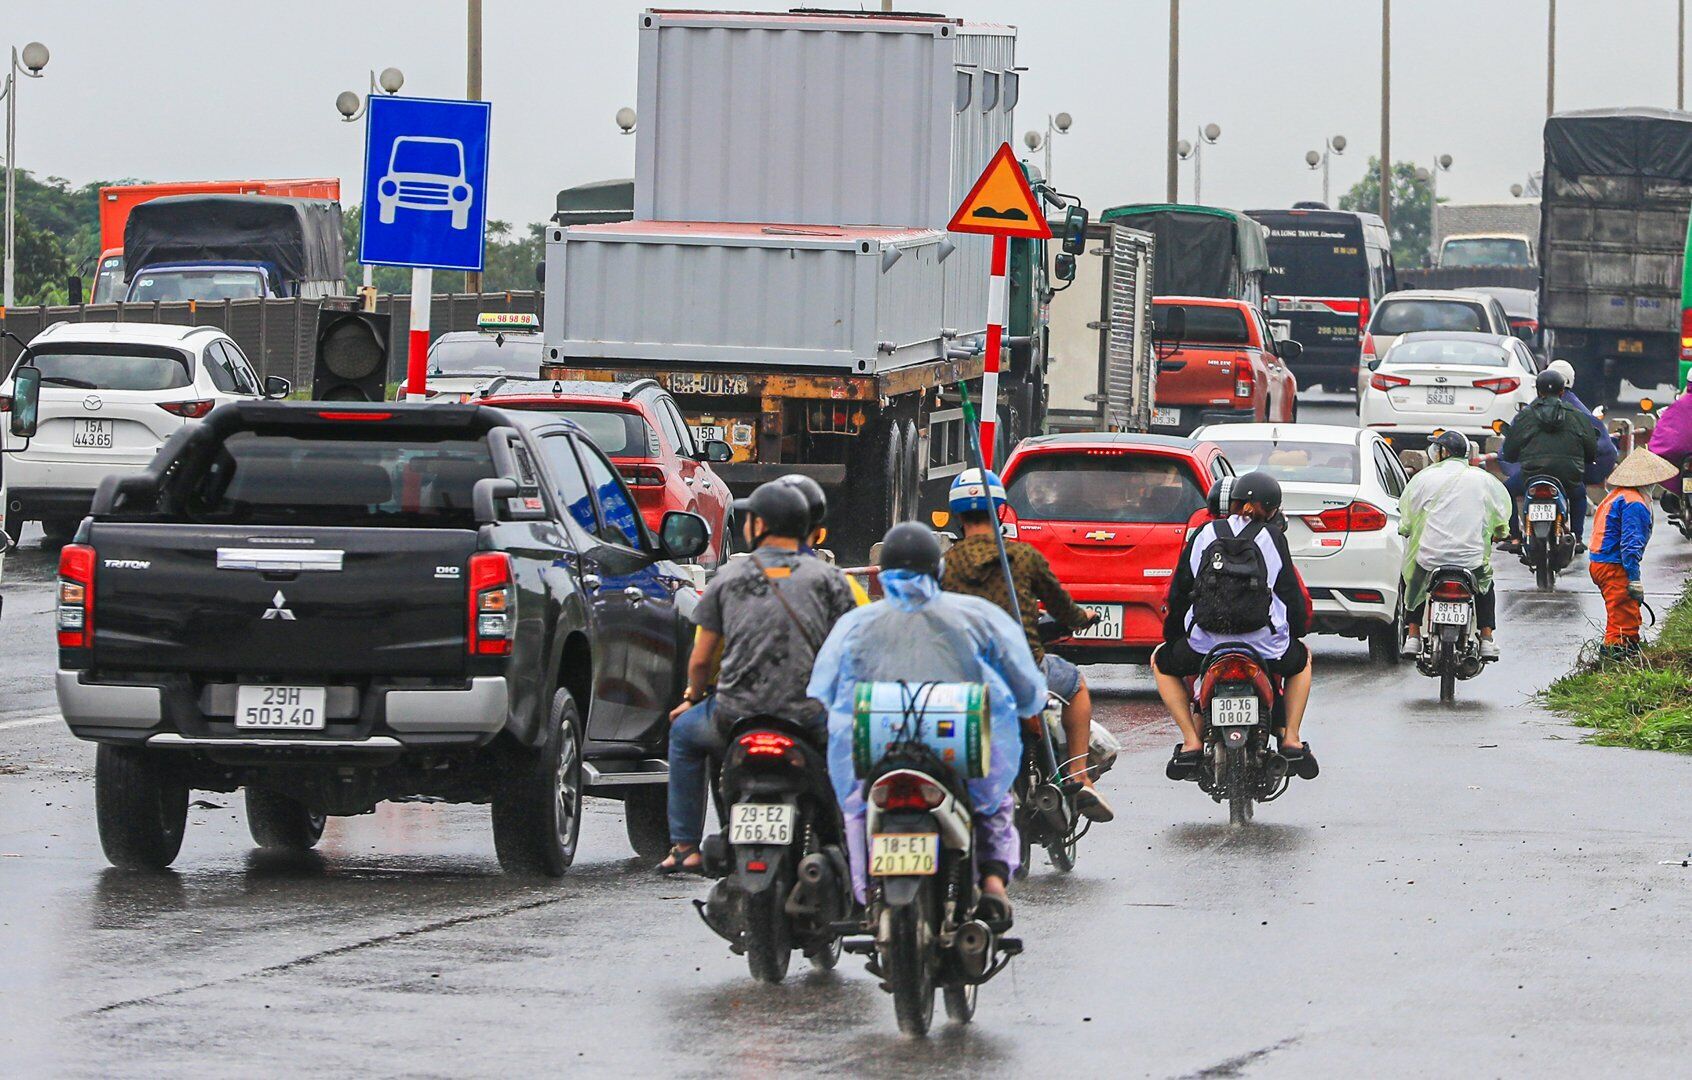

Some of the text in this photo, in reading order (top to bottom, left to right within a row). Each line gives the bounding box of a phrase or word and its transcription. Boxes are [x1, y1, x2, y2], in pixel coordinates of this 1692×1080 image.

[1298, 230, 1320, 238] TRAVEL
[497, 314, 507, 323] 98
[509, 314, 519, 323] 98
[520, 315, 531, 324] 98
[85, 420, 103, 433] 15A
[695, 427, 715, 439] 15R
[74, 433, 111, 446] 443.65
[104, 559, 151, 570] TRITON
[1435, 612, 1466, 623] 234.03
[262, 687, 302, 706] 29H
[1219, 699, 1251, 711] 30-X6
[246, 707, 314, 726] 503.40
[1219, 711, 1251, 724] 0802
[740, 806, 783, 823] 29-E2
[734, 824, 787, 841] 766.46
[882, 836, 927, 854] 18-E1
